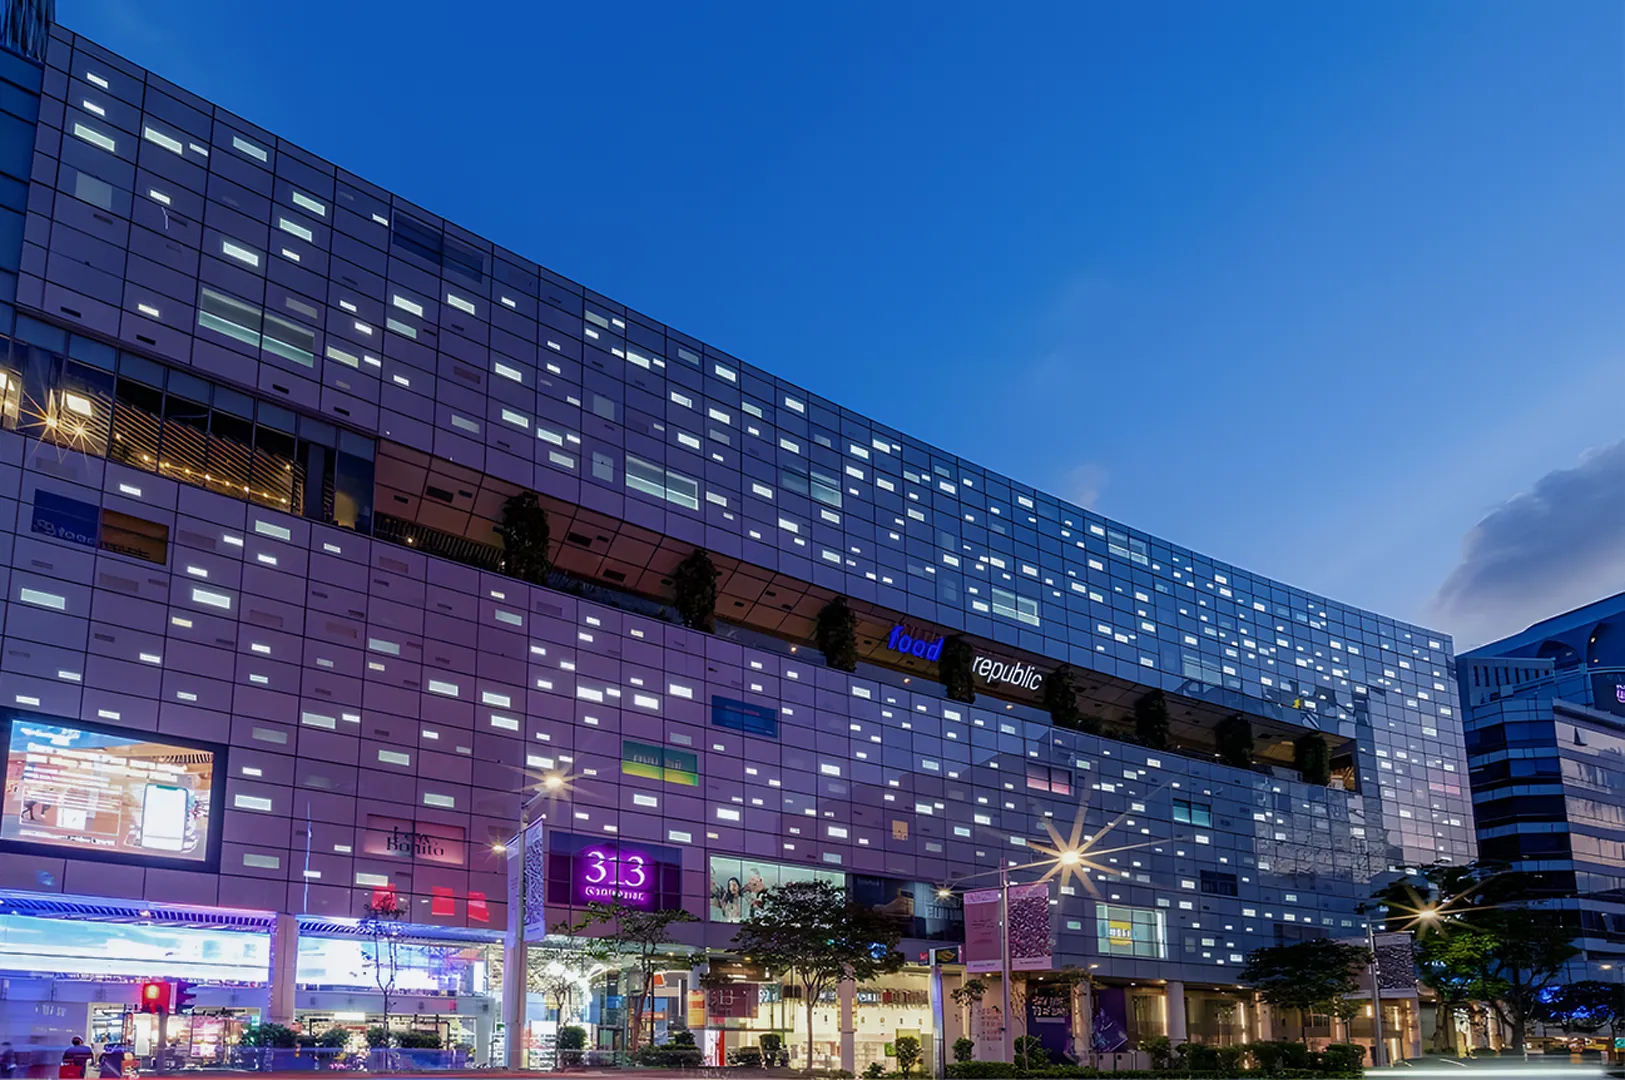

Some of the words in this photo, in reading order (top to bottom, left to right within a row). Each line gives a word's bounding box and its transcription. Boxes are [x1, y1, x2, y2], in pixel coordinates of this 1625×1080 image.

[887, 625, 945, 662] food
[972, 655, 1043, 691] republic
[585, 851, 645, 887] 313
